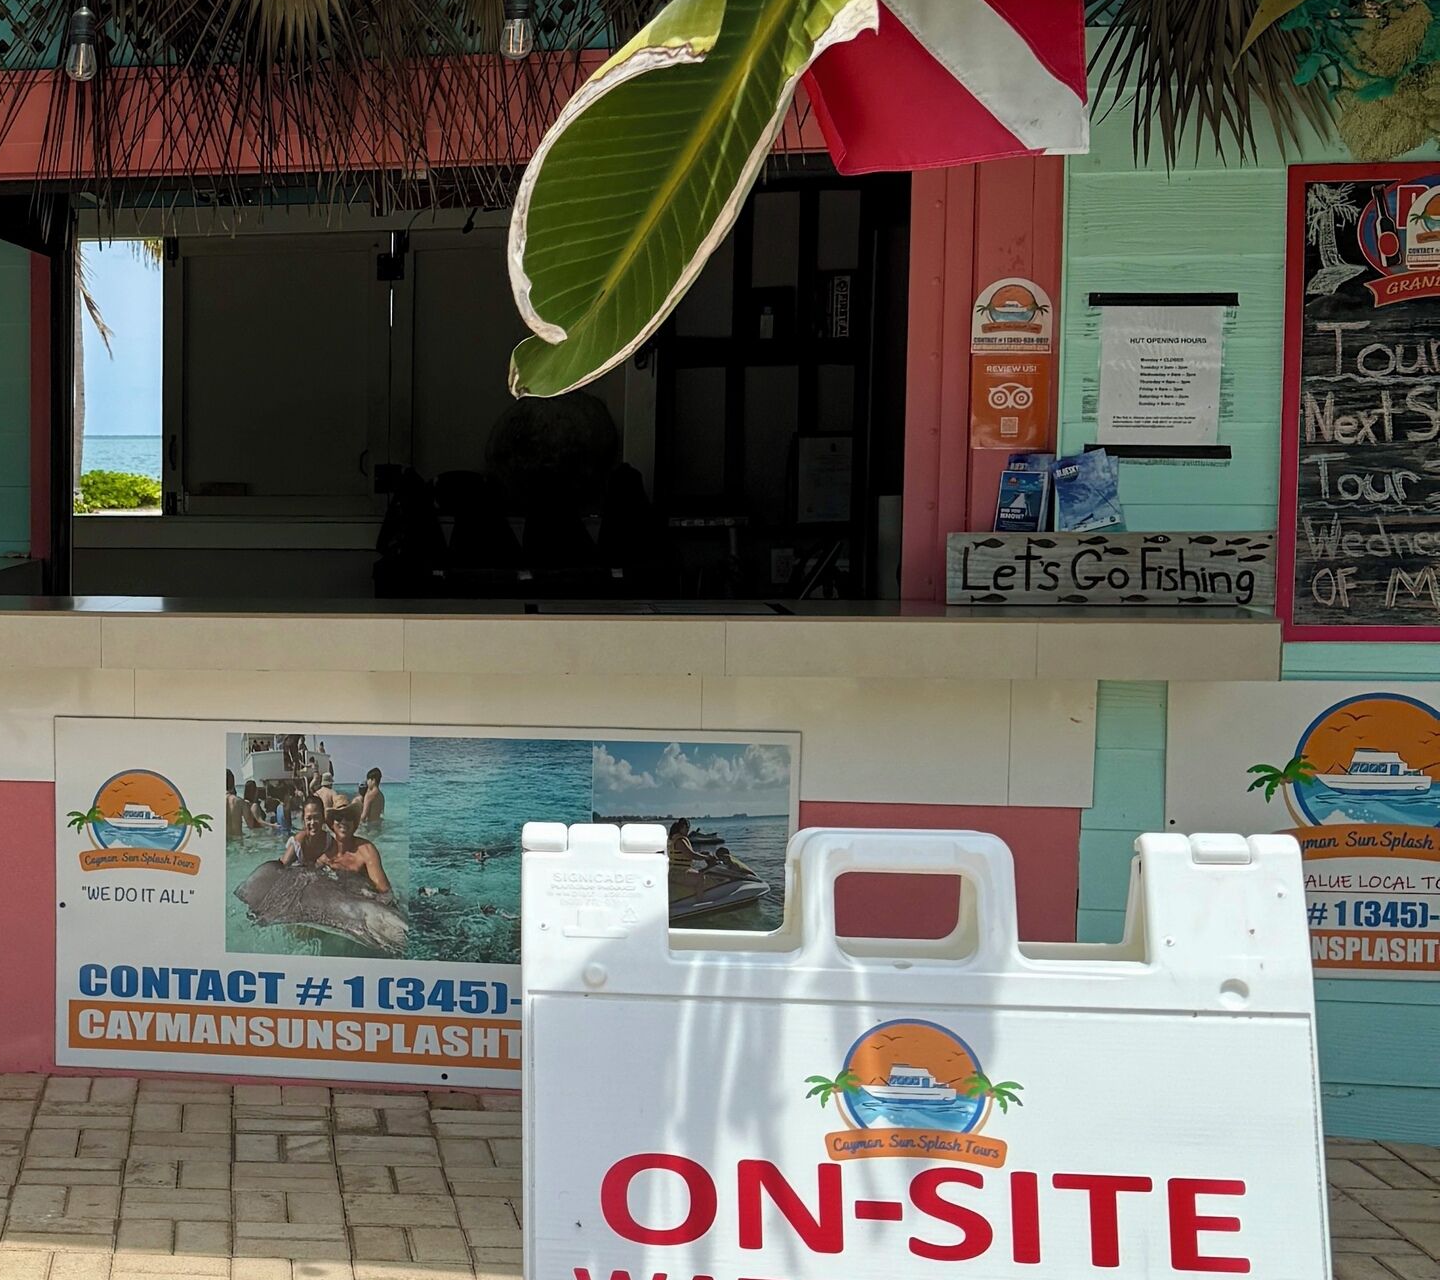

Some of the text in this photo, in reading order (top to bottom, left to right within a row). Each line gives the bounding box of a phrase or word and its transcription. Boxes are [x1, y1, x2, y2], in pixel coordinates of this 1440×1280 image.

[986, 365, 1037, 373] REVIEW US!
[1304, 385, 1440, 448] Next S
[1302, 452, 1422, 505] Tour
[961, 544, 1256, 605] Let's Go Fishing
[1312, 566, 1359, 608] OF
[1301, 830, 1435, 854] yman Sun Splash
[84, 852, 196, 869] Cayman Sun Splash Tours
[81, 885, 195, 904] "WE DO IT ALL"
[1305, 874, 1353, 889] ALUE
[1359, 875, 1416, 891] LOCAL
[78, 963, 286, 1003] CONTACT
[295, 976, 333, 1007] #
[343, 975, 365, 1009] 1
[833, 1134, 1000, 1159] Cayman Sun Splash Tours
[600, 1151, 1252, 1274] ON-SITE
